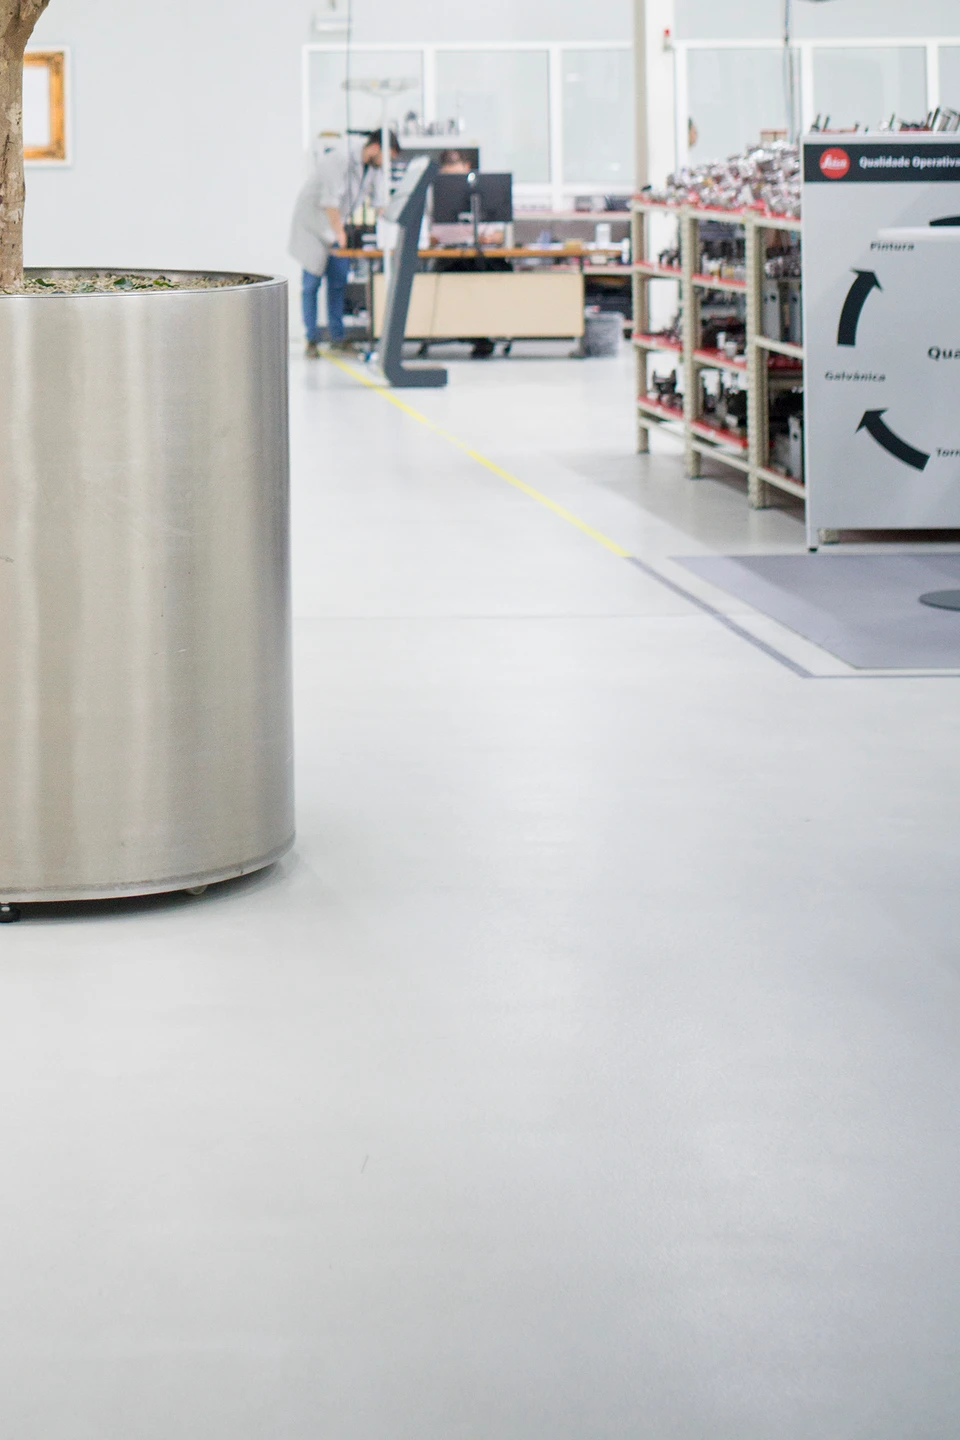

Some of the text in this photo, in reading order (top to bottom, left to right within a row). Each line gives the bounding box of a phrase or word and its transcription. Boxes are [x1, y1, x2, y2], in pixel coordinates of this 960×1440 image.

[821, 154, 848, 170] Leica
[859, 155, 960, 170] Qualidade Operativa
[869, 241, 915, 251] Pintura
